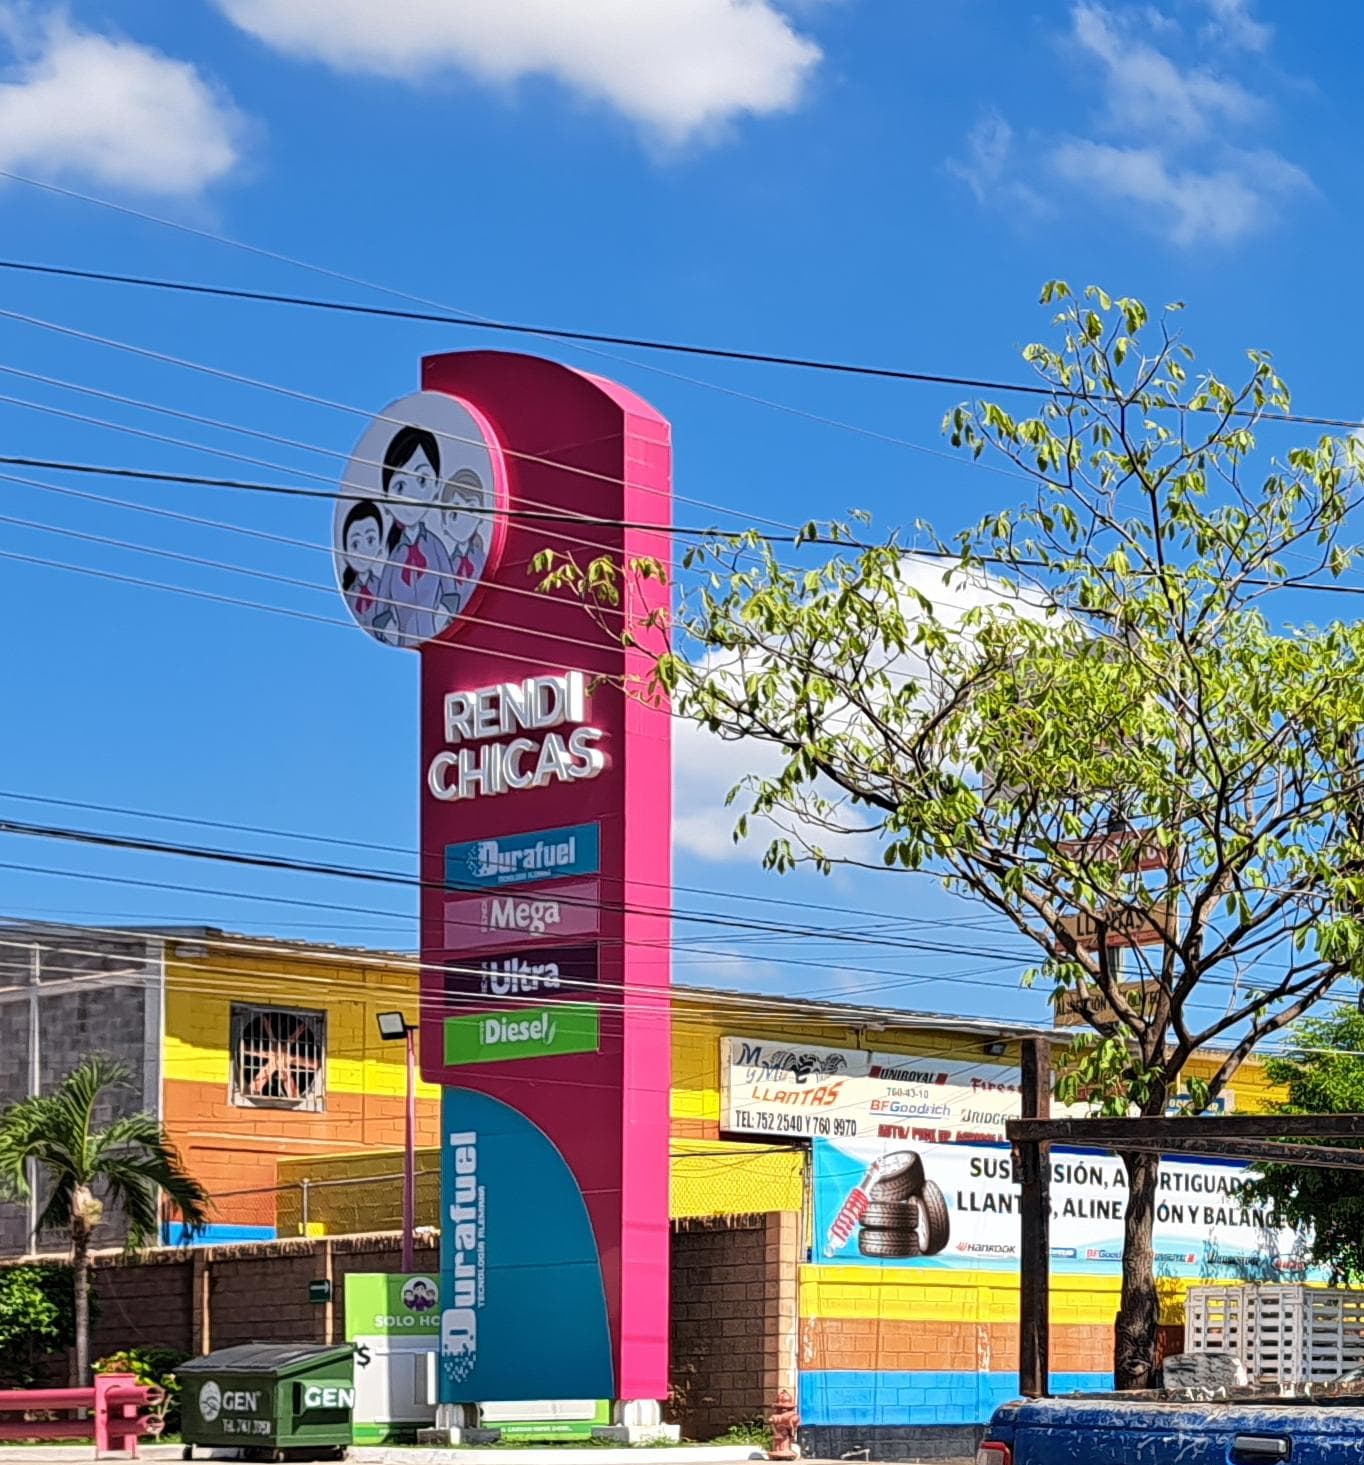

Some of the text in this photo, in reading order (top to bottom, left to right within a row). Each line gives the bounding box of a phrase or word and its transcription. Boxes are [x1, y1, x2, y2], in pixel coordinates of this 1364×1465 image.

[445, 671, 584, 743] RENDI
[428, 727, 607, 801] CHICAS
[473, 836, 576, 878] Durafuel
[490, 896, 560, 937] Mega
[490, 957, 561, 995] Ultra
[485, 1012, 549, 1045] Diesel
[880, 1067, 934, 1084] UNIROYAL
[969, 1077, 1021, 1095] Fires
[751, 1080, 846, 1107] LLANTAS
[870, 1099, 951, 1116] BFGoodrich
[735, 1109, 857, 1137] TEL: 752 2540 Y 760 9970
[970, 1156, 1109, 1190] SUSSIÓN,
[957, 1190, 1058, 1220] LLANT,
[1062, 1198, 1188, 1224] ALINEÓN
[1189, 1206, 1199, 1224] Y
[442, 1131, 477, 1359] Durafuel
[374, 1315, 415, 1328] SOLO
[223, 1390, 257, 1412] GEN
[304, 1386, 356, 1409] GEN
